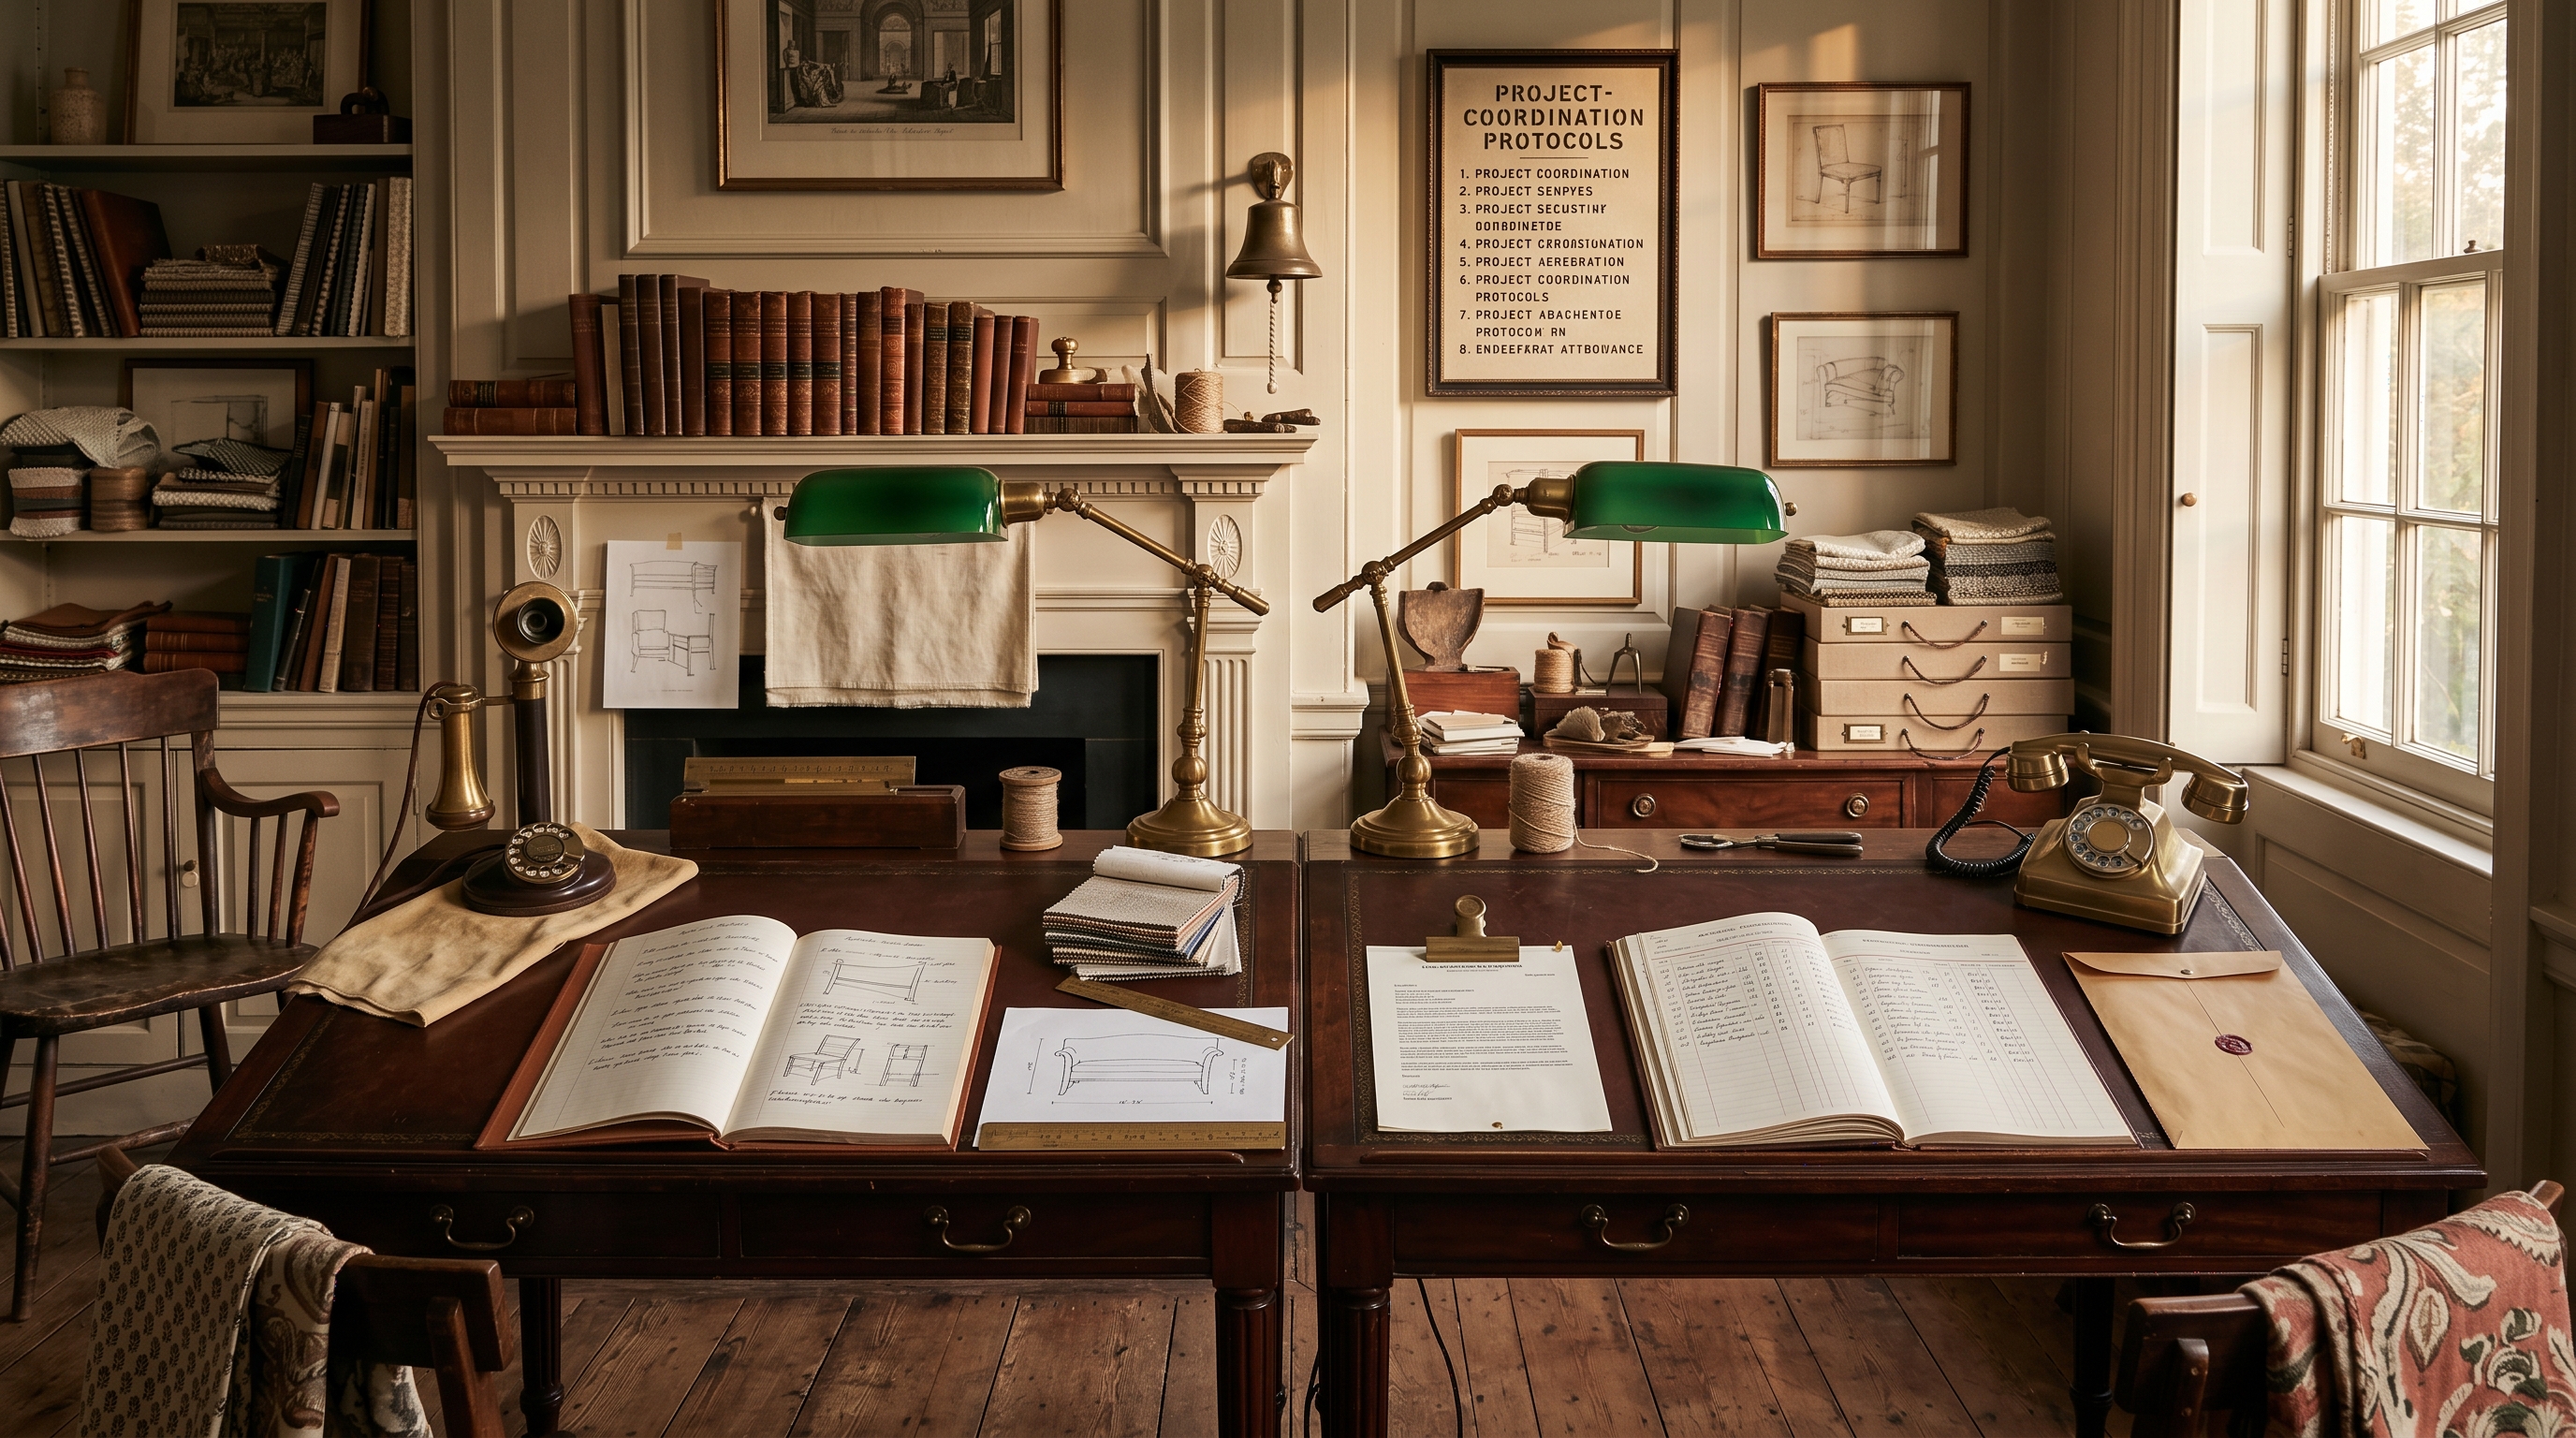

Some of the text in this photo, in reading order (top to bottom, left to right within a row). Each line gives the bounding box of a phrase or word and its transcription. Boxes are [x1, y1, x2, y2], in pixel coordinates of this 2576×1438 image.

[1496, 84, 1613, 103] PROJECT-
[1463, 108, 1644, 126] COORDINATION
[1484, 131, 1624, 151] PROTOCOLS
[1459, 168, 1630, 180] 1. PROJECT COORDINATION
[1459, 185, 1593, 197] 2. PROJECT SENPYES
[1459, 203, 1471, 214] 3.
[1476, 203, 1532, 214] PROJECT
[1459, 238, 1471, 249] 4.
[1476, 238, 1532, 249] PROJECT
[1459, 257, 1624, 268] 5. PROJECT AEREBRATION
[1459, 274, 1630, 286] 6. PROJECT COORDINATION
[1475, 291, 1549, 302] PROTOCOLS
[1459, 309, 1622, 320] 7. PROJECT ABACHENTOE
[1550, 327, 1566, 338] RN
[1459, 344, 1471, 355] 8.
